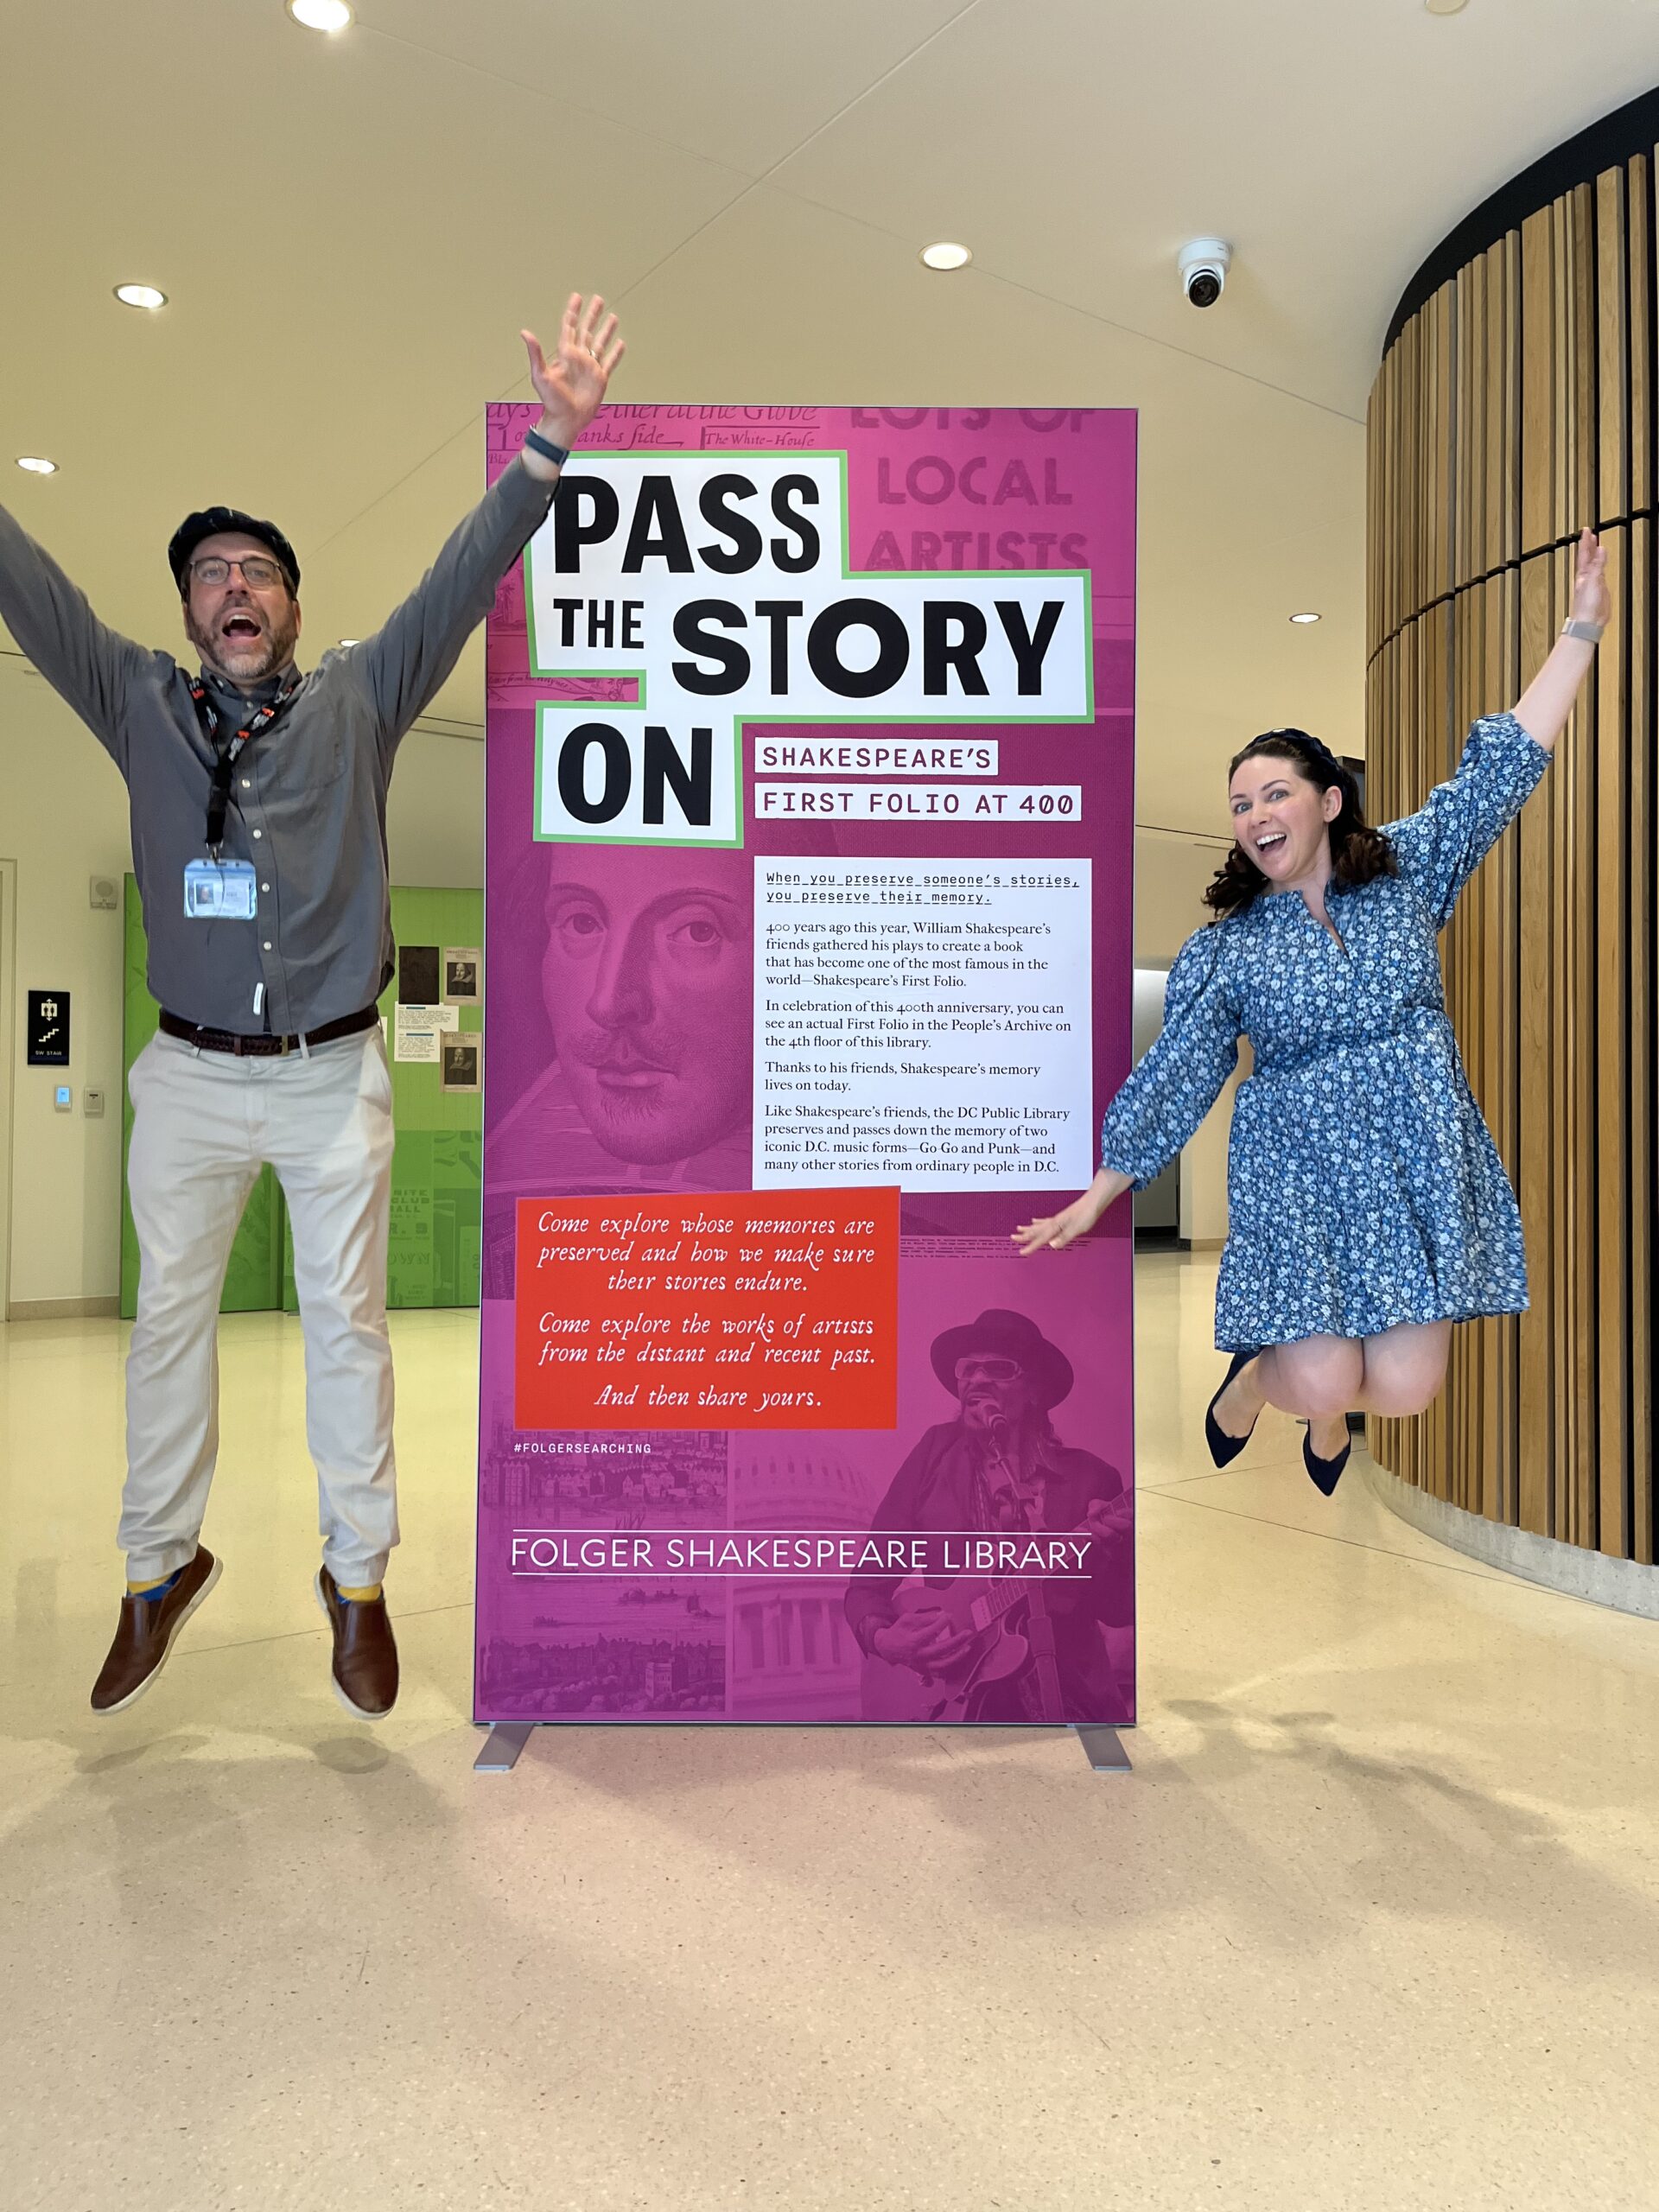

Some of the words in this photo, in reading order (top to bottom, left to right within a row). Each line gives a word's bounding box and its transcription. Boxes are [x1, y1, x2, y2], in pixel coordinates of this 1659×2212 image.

[706, 433, 728, 445] The
[877, 455, 1072, 505] LOCAL
[554, 474, 820, 574] PASS
[865, 531, 1089, 571] ARTISTS
[553, 599, 644, 649] THE
[672, 598, 1065, 698] STORY
[764, 747, 989, 768] SHAKESPEARE’S
[557, 722, 712, 826] ON
[765, 792, 853, 812] FIRST
[871, 794, 958, 813] FOLIO
[976, 795, 1007, 813] AT
[1020, 795, 1072, 814] 400
[766, 872, 800, 884] When
[810, 874, 835, 886] you
[845, 874, 913, 887] preserve
[924, 874, 1001, 887] someone’s
[1011, 874, 1079, 887] stories,
[766, 892, 791, 903] you
[802, 892, 869, 904] preserve
[880, 891, 922, 904] their
[931, 893, 991, 905] memory.
[766, 925, 791, 935] 400
[794, 925, 827, 935] years
[830, 925, 851, 936] ago
[855, 922, 877, 933] this
[880, 925, 910, 936] year,
[913, 923, 963, 934] William
[966, 923, 1052, 938] Shakespeare’s
[767, 938, 810, 950] friends
[813, 940, 868, 953] gathered
[872, 940, 890, 951] his
[893, 940, 924, 954] plays
[927, 942, 939, 951] to
[943, 943, 982, 951] create
[994, 941, 1024, 952] book
[766, 957, 791, 968] that
[795, 957, 815, 968] has
[817, 957, 865, 969] become
[868, 961, 891, 969] one
[893, 957, 910, 969] of
[908, 957, 930, 969] the
[933, 958, 962, 969] most
[966, 958, 1009, 970] famous
[1013, 958, 1025, 970] in
[1028, 959, 1049, 970] the
[903, 975, 931, 987] First
[934, 976, 967, 987] Folio.
[766, 1000, 780, 1011] In
[783, 1001, 852, 1012] celebration
[855, 1001, 872, 1013] of
[871, 1001, 894, 1013] this
[897, 1002, 934, 1016] 400th
[938, 1002, 1014, 1017] anniversary,
[1017, 1005, 1039, 1017] you
[1043, 1005, 1065, 1014] can
[807, 1019, 843, 1030] actual
[848, 1018, 875, 1030] First
[880, 1019, 909, 1030] Folio
[912, 1020, 925, 1031] in
[928, 1020, 949, 1031] the
[952, 1020, 1001, 1034] People’s
[1004, 1020, 1053, 1032] Archive
[1056, 1023, 1071, 1032] on
[766, 1035, 786, 1046] the
[789, 1036, 810, 1050] 4th
[814, 1036, 843, 1047] floor
[846, 1036, 862, 1048] of
[861, 1036, 884, 1048] this
[887, 1036, 931, 1052] library.
[765, 1062, 811, 1073] Thanks
[814, 1065, 827, 1073] to
[830, 1062, 848, 1073] his
[851, 1062, 898, 1075] friends,
[901, 1063, 986, 1077] Shakespeare’s
[989, 1066, 1041, 1077] memory
[766, 1079, 793, 1090] lives
[815, 1080, 851, 1094] today.
[766, 1105, 792, 1116] Like
[796, 1106, 880, 1121] Shakespeare’s
[885, 1106, 931, 1119] friends,
[934, 1108, 955, 1118] the
[958, 1107, 978, 1119] DC
[982, 1108, 1020, 1119] Public
[1024, 1108, 1071, 1122] Library
[766, 1126, 824, 1138] preserves
[827, 1124, 849, 1135] and
[854, 1127, 891, 1139] passes
[893, 1124, 927, 1136] down
[931, 1125, 952, 1136] the
[955, 1127, 1007, 1141] memory
[1009, 1125, 1026, 1137] of
[1025, 1126, 1049, 1137] two
[766, 1141, 802, 1152] iconic
[805, 1141, 830, 1153] D.C.
[834, 1141, 869, 1153] music
[962, 1143, 984, 1154] and
[765, 1161, 798, 1173] many
[802, 1160, 836, 1171] other
[839, 1160, 880, 1171] stories
[883, 1160, 913, 1171] from
[916, 1160, 970, 1174] ordinary
[974, 1161, 1015, 1175] people
[1018, 1161, 1031, 1173] in
[1035, 1161, 1059, 1173] D.C.
[538, 1211, 589, 1233] Come
[600, 1211, 670, 1240] explore
[680, 1212, 734, 1233] whose
[745, 1219, 836, 1234] memories
[844, 1220, 875, 1235] are
[537, 1240, 635, 1268] preserved
[641, 1240, 682, 1262] and
[690, 1240, 728, 1262] how
[739, 1249, 764, 1262] we
[773, 1242, 824, 1272] make
[832, 1249, 875, 1263] sure
[607, 1268, 657, 1290] their
[664, 1274, 727, 1290] stories
[734, 1269, 807, 1292] endure.
[538, 1312, 590, 1333] Come
[601, 1312, 671, 1341] explore
[682, 1313, 711, 1333] the
[721, 1313, 775, 1344] works
[783, 1313, 806, 1338] of
[812, 1319, 874, 1335] artists
[537, 1340, 588, 1366] from
[596, 1340, 626, 1362] the
[636, 1340, 707, 1363] distant
[715, 1341, 756, 1363] and
[764, 1347, 822, 1363] recent
[830, 1348, 875, 1371] past.
[594, 1383, 640, 1406] And
[648, 1383, 690, 1406] then
[697, 1384, 748, 1406] share
[753, 1391, 822, 1413] yours.
[513, 1442, 652, 1454] #FOLGERSEARCHING
[511, 1538, 653, 1567] FOLGER
[667, 1540, 927, 1567] SHAKESPEARE
[945, 1541, 1090, 1568] LIBRARY
